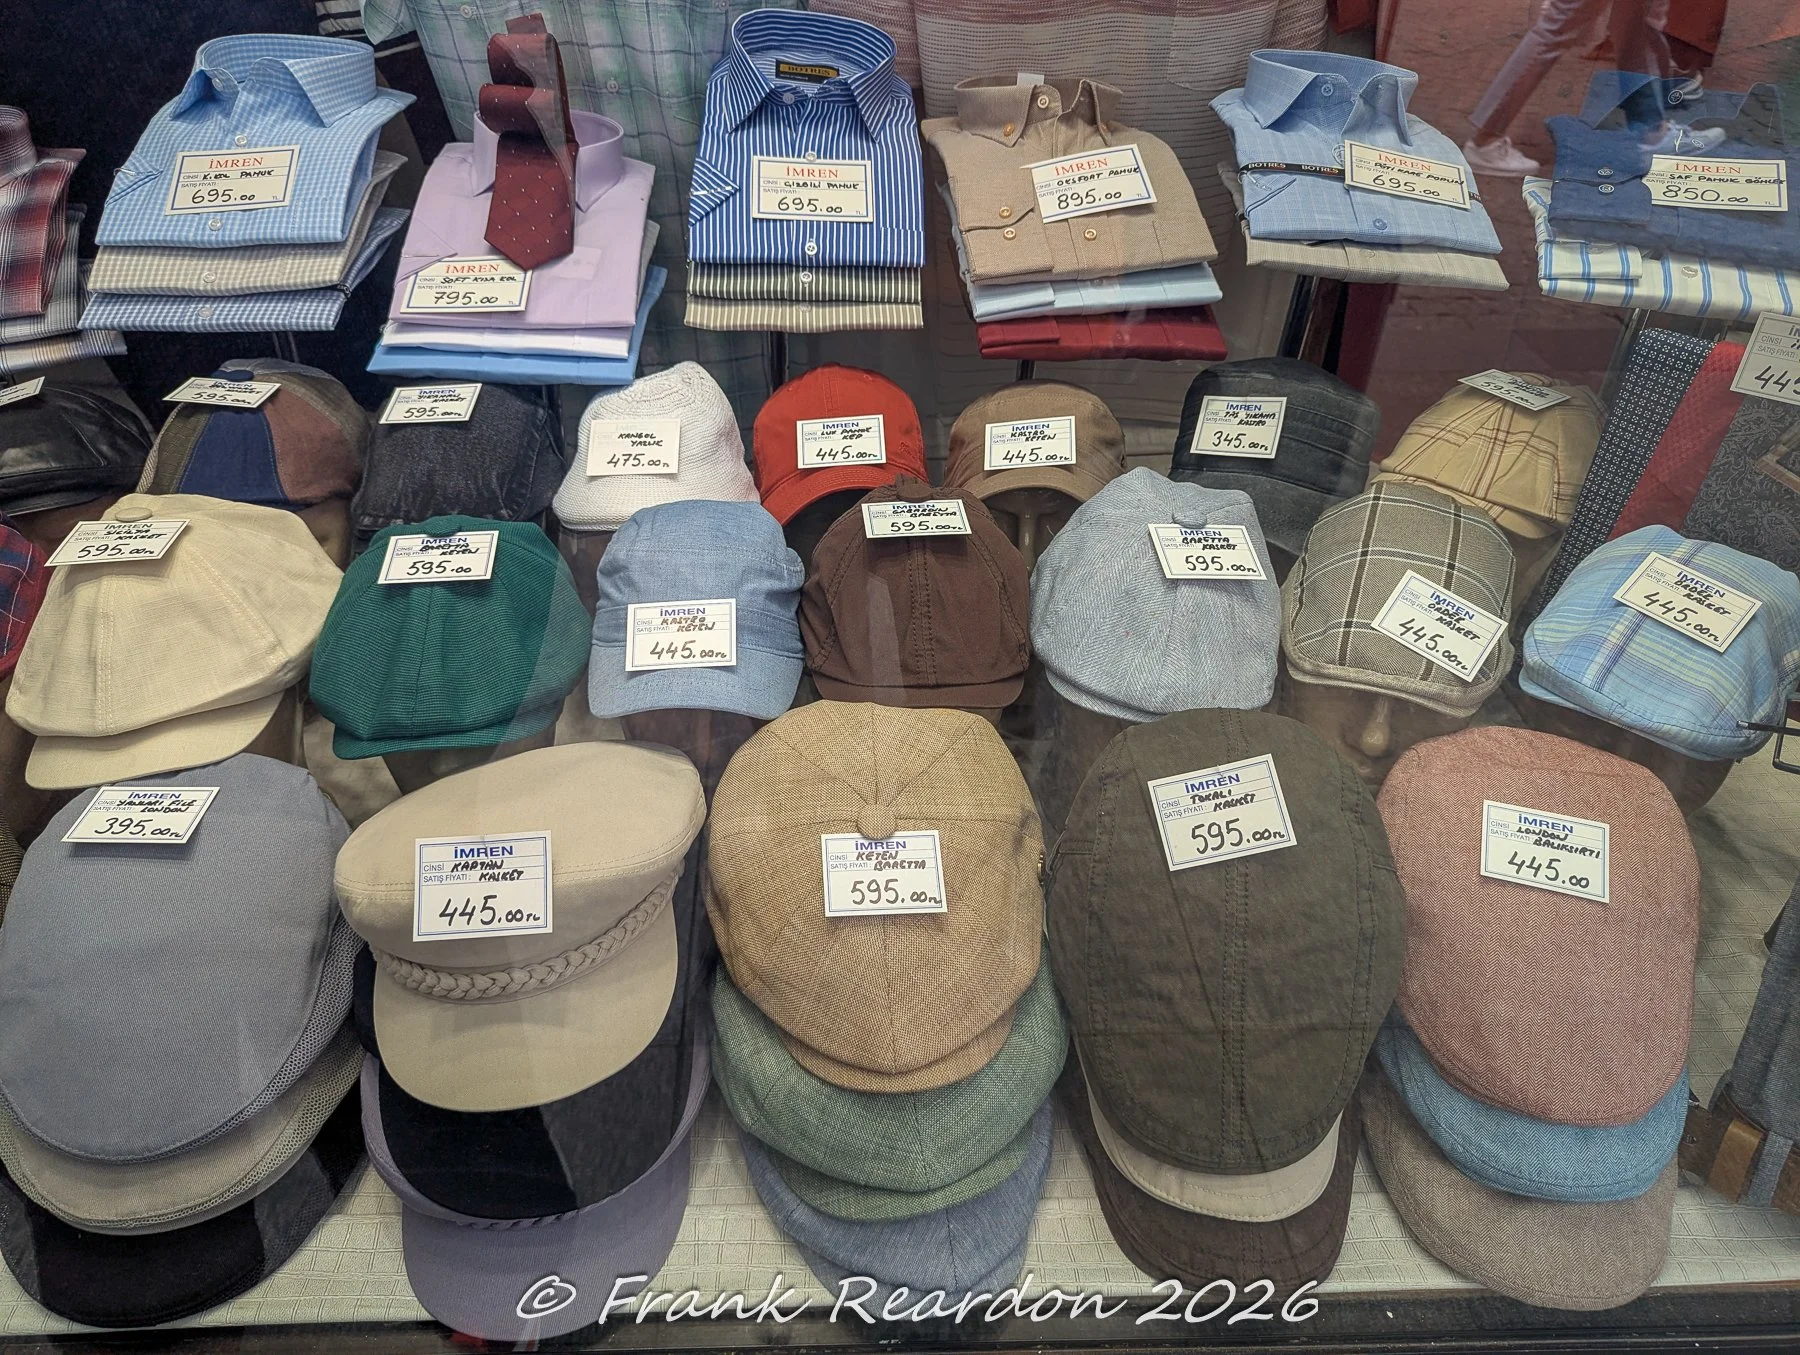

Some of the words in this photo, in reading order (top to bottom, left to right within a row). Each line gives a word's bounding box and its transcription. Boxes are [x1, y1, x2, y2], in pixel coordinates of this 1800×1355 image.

[240, 169, 275, 178] PAMUK
[1108, 165, 1141, 176] PAMUK
[1301, 164, 1339, 173] BOTRES
[1372, 174, 1440, 197] 695.00
[1698, 175, 1740, 183] PAMUK
[191, 189, 256, 204] 695.00
[1057, 188, 1122, 209] 895.00
[1662, 184, 1749, 203] 850.00
[777, 196, 843, 213] 695.00
[434, 291, 499, 305] 795.00
[1201, 543, 1238, 551] KASKET
[406, 560, 471, 576] 595.00
[660, 615, 706, 625] KASTRO
[1184, 773, 1241, 794] İMREN
[1163, 809, 1183, 819] SATIŞ
[1518, 813, 1573, 834] İMREN
[1516, 826, 1569, 841] LONDON
[454, 845, 513, 859] İMREN
[855, 840, 907, 850] İMREN
[855, 850, 899, 861] KETEN
[450, 859, 504, 873] KAPTAN
[873, 859, 926, 872] BARETTA
[1507, 850, 1590, 889] 445.00
